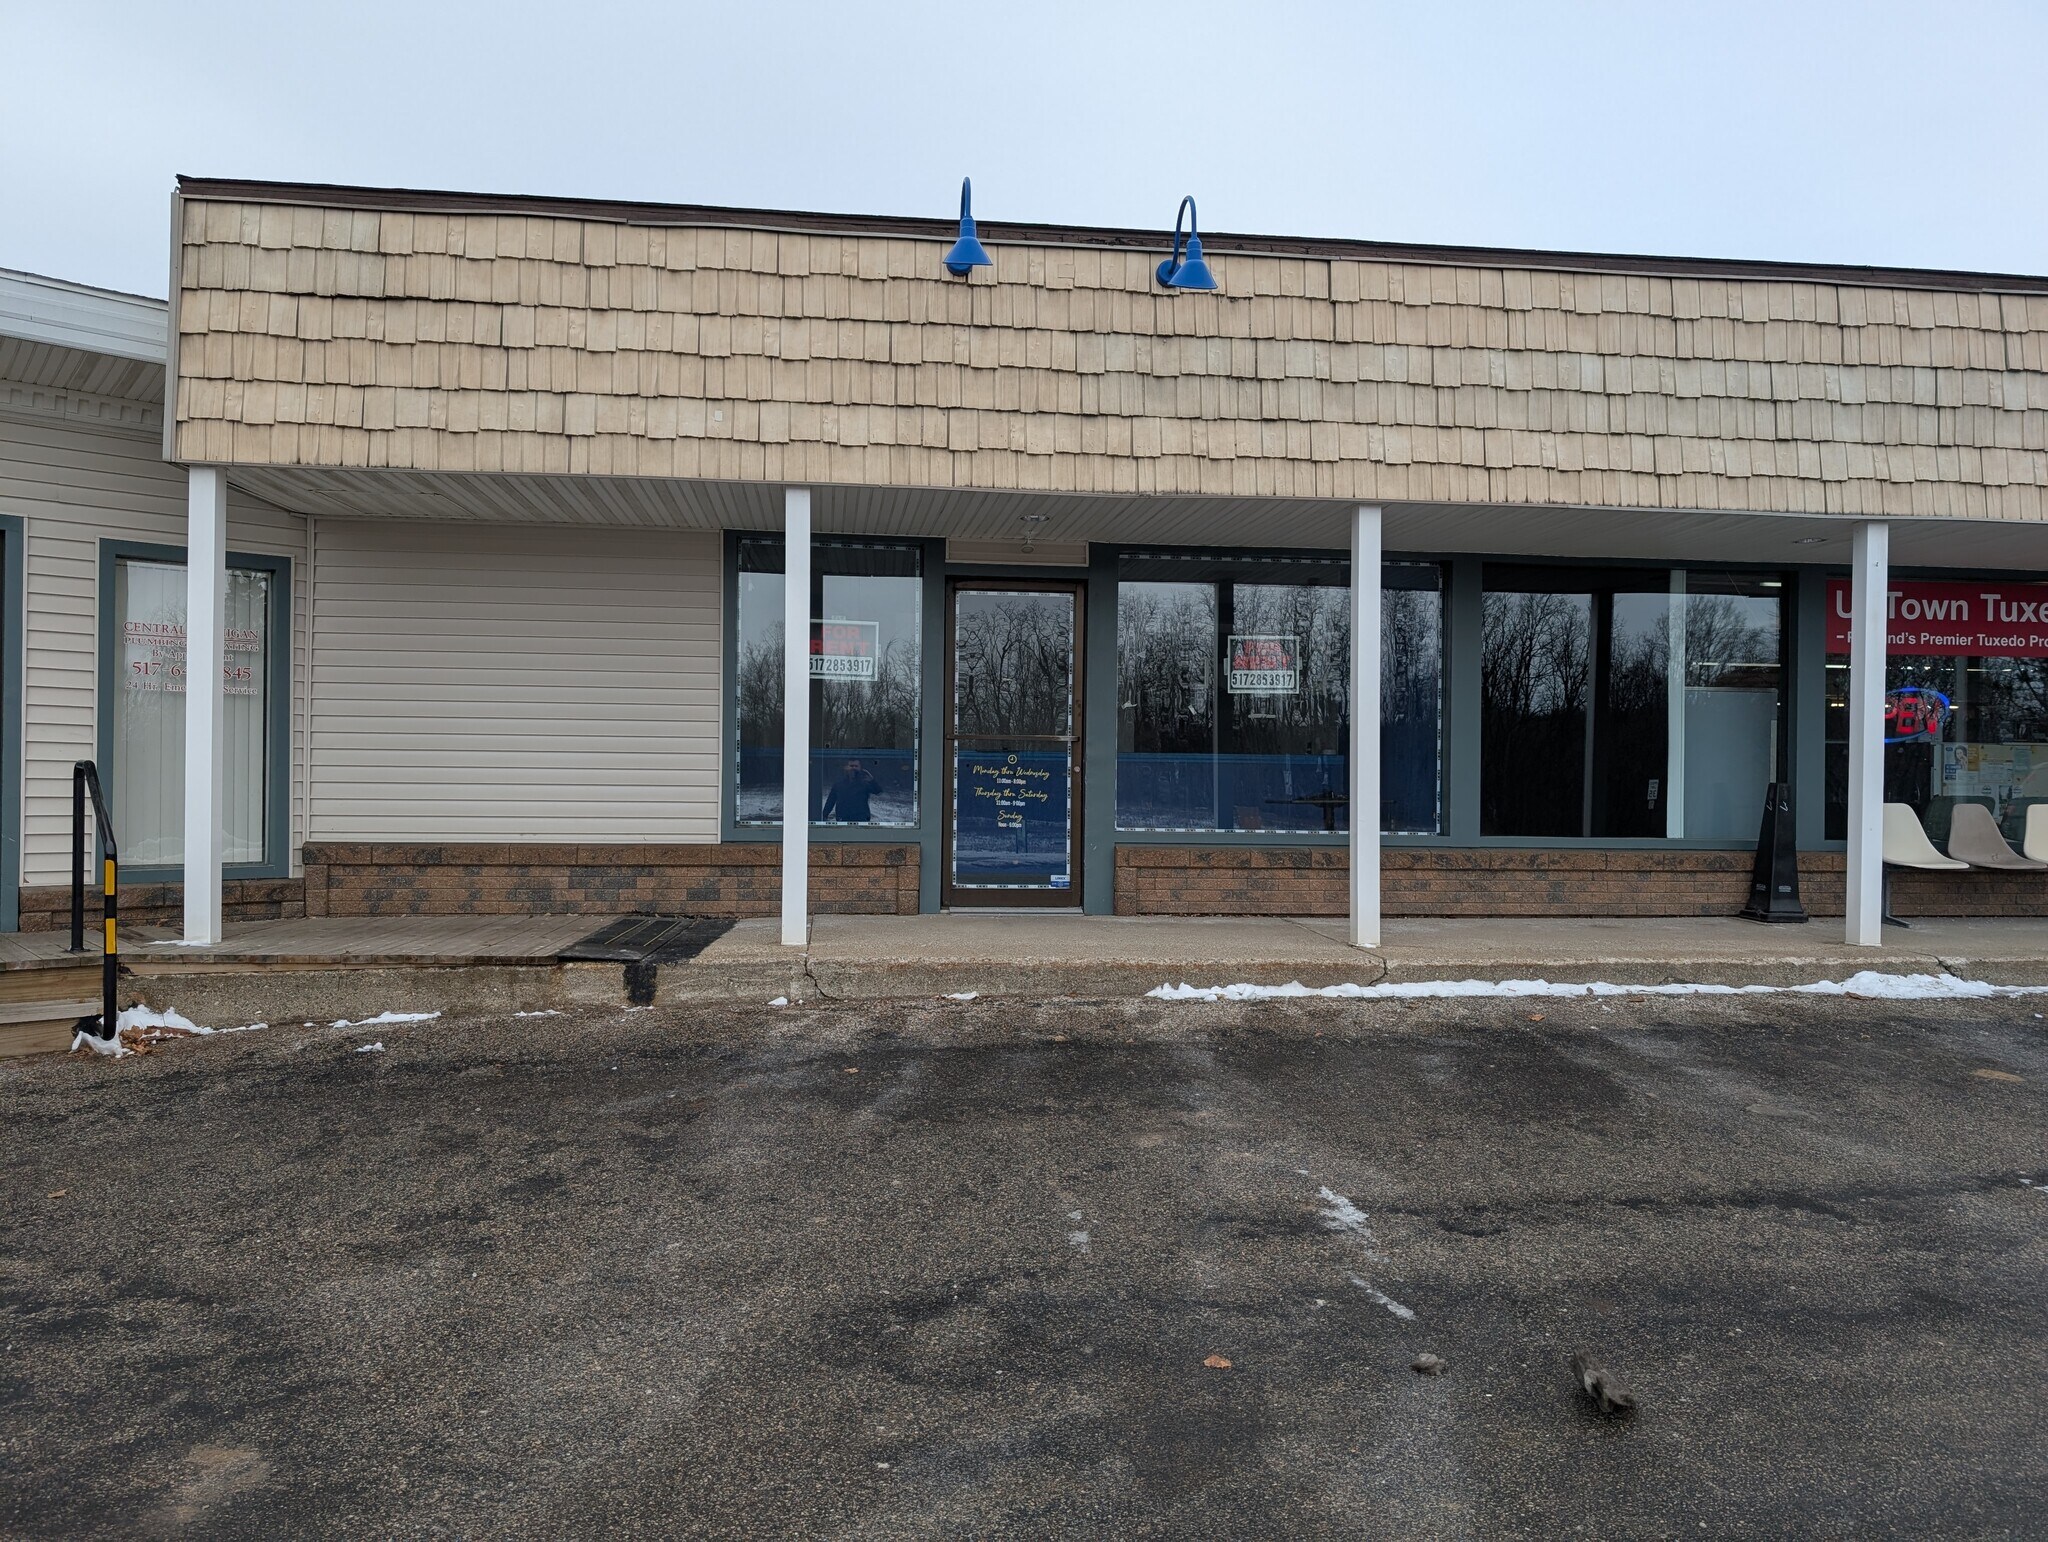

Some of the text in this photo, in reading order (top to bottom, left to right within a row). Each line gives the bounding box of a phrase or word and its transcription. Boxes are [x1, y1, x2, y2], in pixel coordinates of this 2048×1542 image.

[124, 621, 187, 635] CENTRAL
[822, 625, 860, 639] FOR
[124, 637, 187, 647] PLUMBING
[810, 640, 869, 655] RENT
[1920, 634, 1973, 646] Premier
[1977, 634, 2026, 647] Tuxedo
[152, 649, 164, 659] By
[1232, 673, 1293, 686] 5172853917
[126, 681, 138, 690] 24
[223, 685, 257, 695] Service
[973, 765, 1000, 778] Monday
[1015, 767, 1050, 780] Wednesday
[974, 787, 1002, 800] Thursday
[1018, 788, 1048, 802] Saturday
[997, 810, 1023, 823] Sunday
